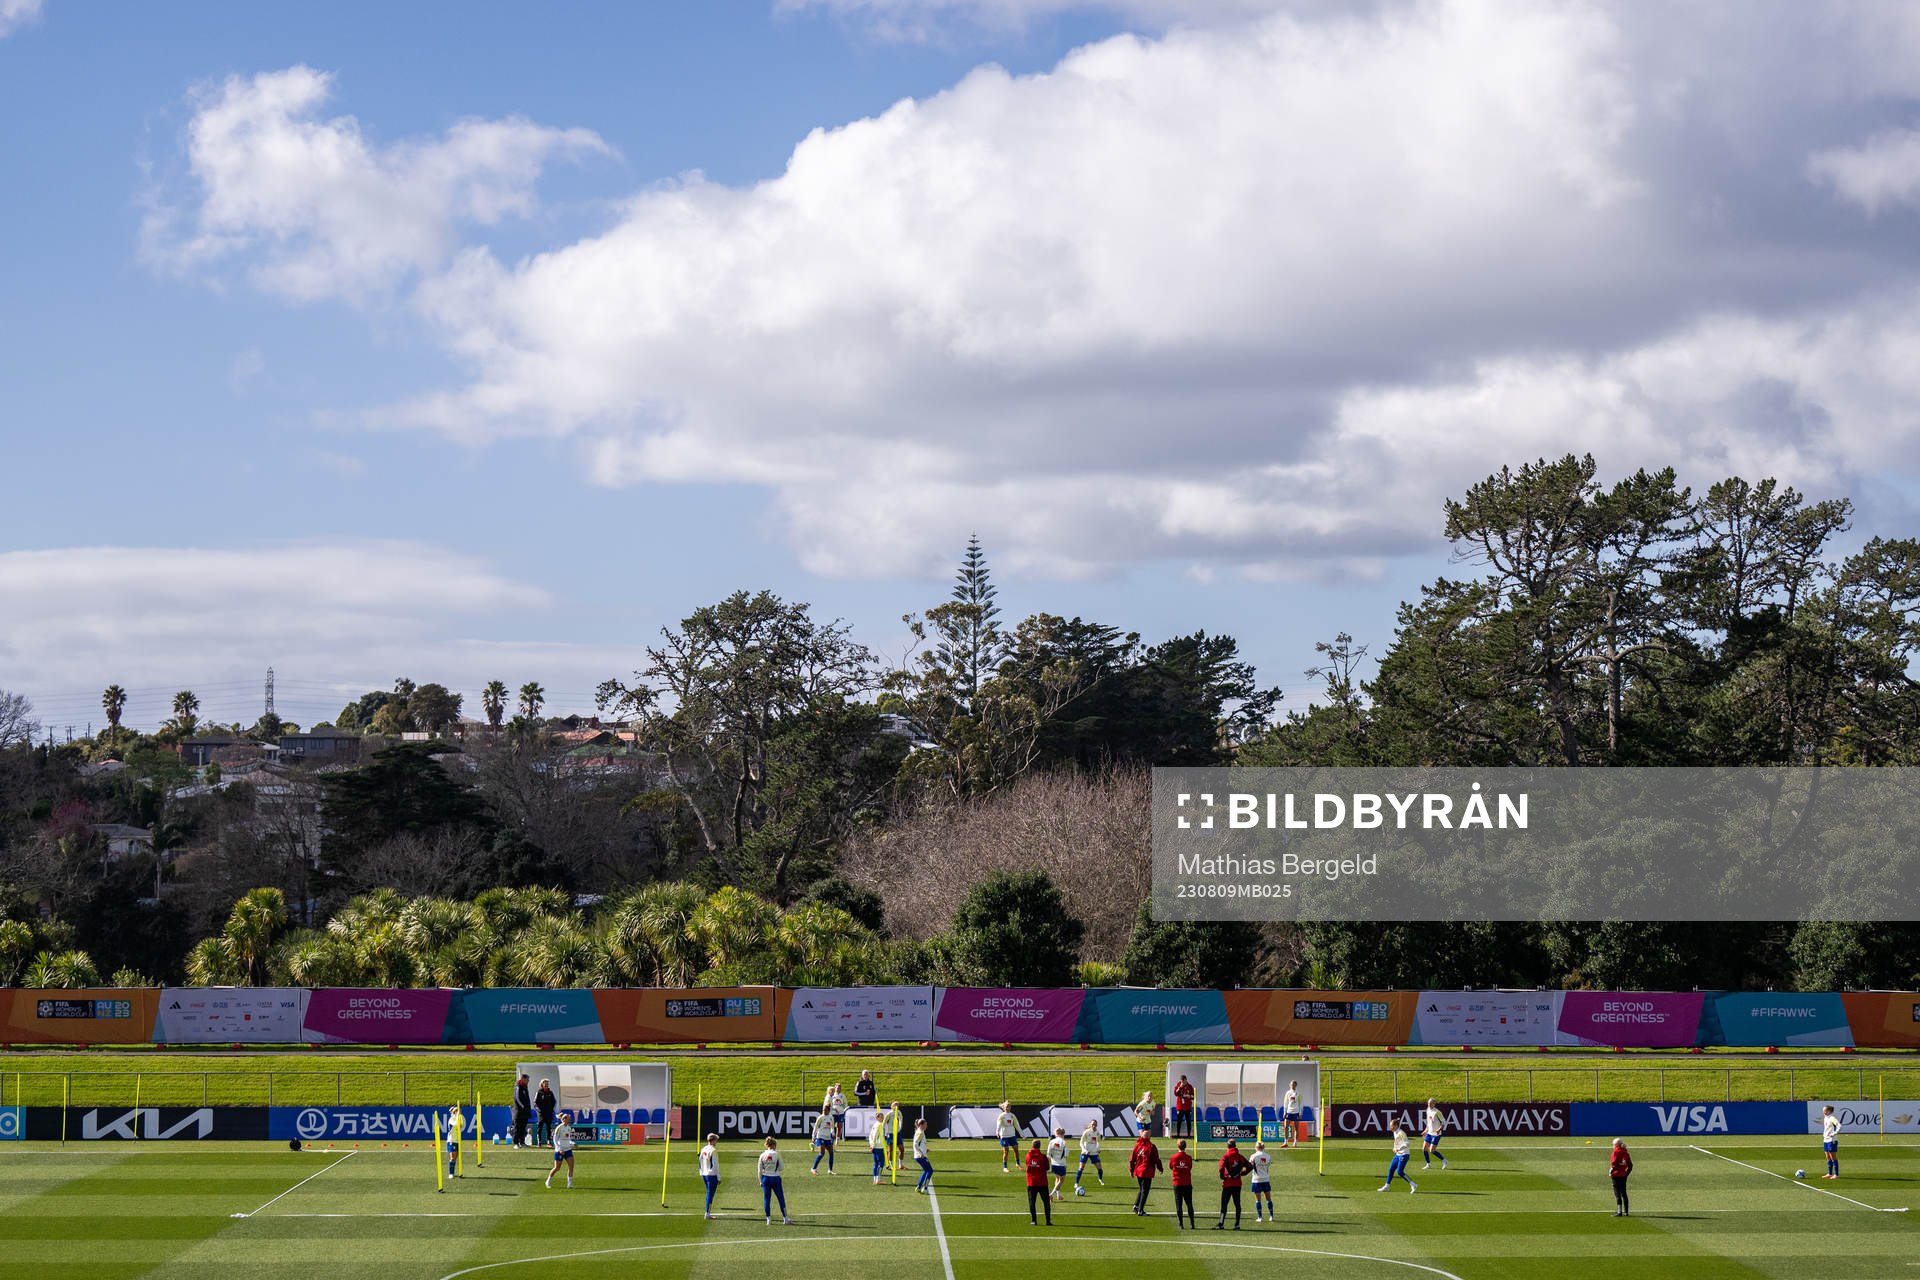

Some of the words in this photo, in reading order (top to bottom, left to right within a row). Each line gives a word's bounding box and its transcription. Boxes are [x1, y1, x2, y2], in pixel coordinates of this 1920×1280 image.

[96, 1001, 112, 1009] AU
[349, 998, 400, 1008] BEYOND
[726, 999, 742, 1007] AU
[983, 998, 1034, 1007] BEYOND
[1603, 1002, 1654, 1012] BEYOND
[500, 1003, 567, 1014] #FIFAWWC
[1131, 1005, 1198, 1015] #FIFAWWC
[1751, 1007, 1817, 1018] #FIFAWWC
[332, 1113, 388, 1135] 万达
[1443, 1109, 1564, 1131] AIRWAYS
[1649, 1106, 1729, 1132] VISA
